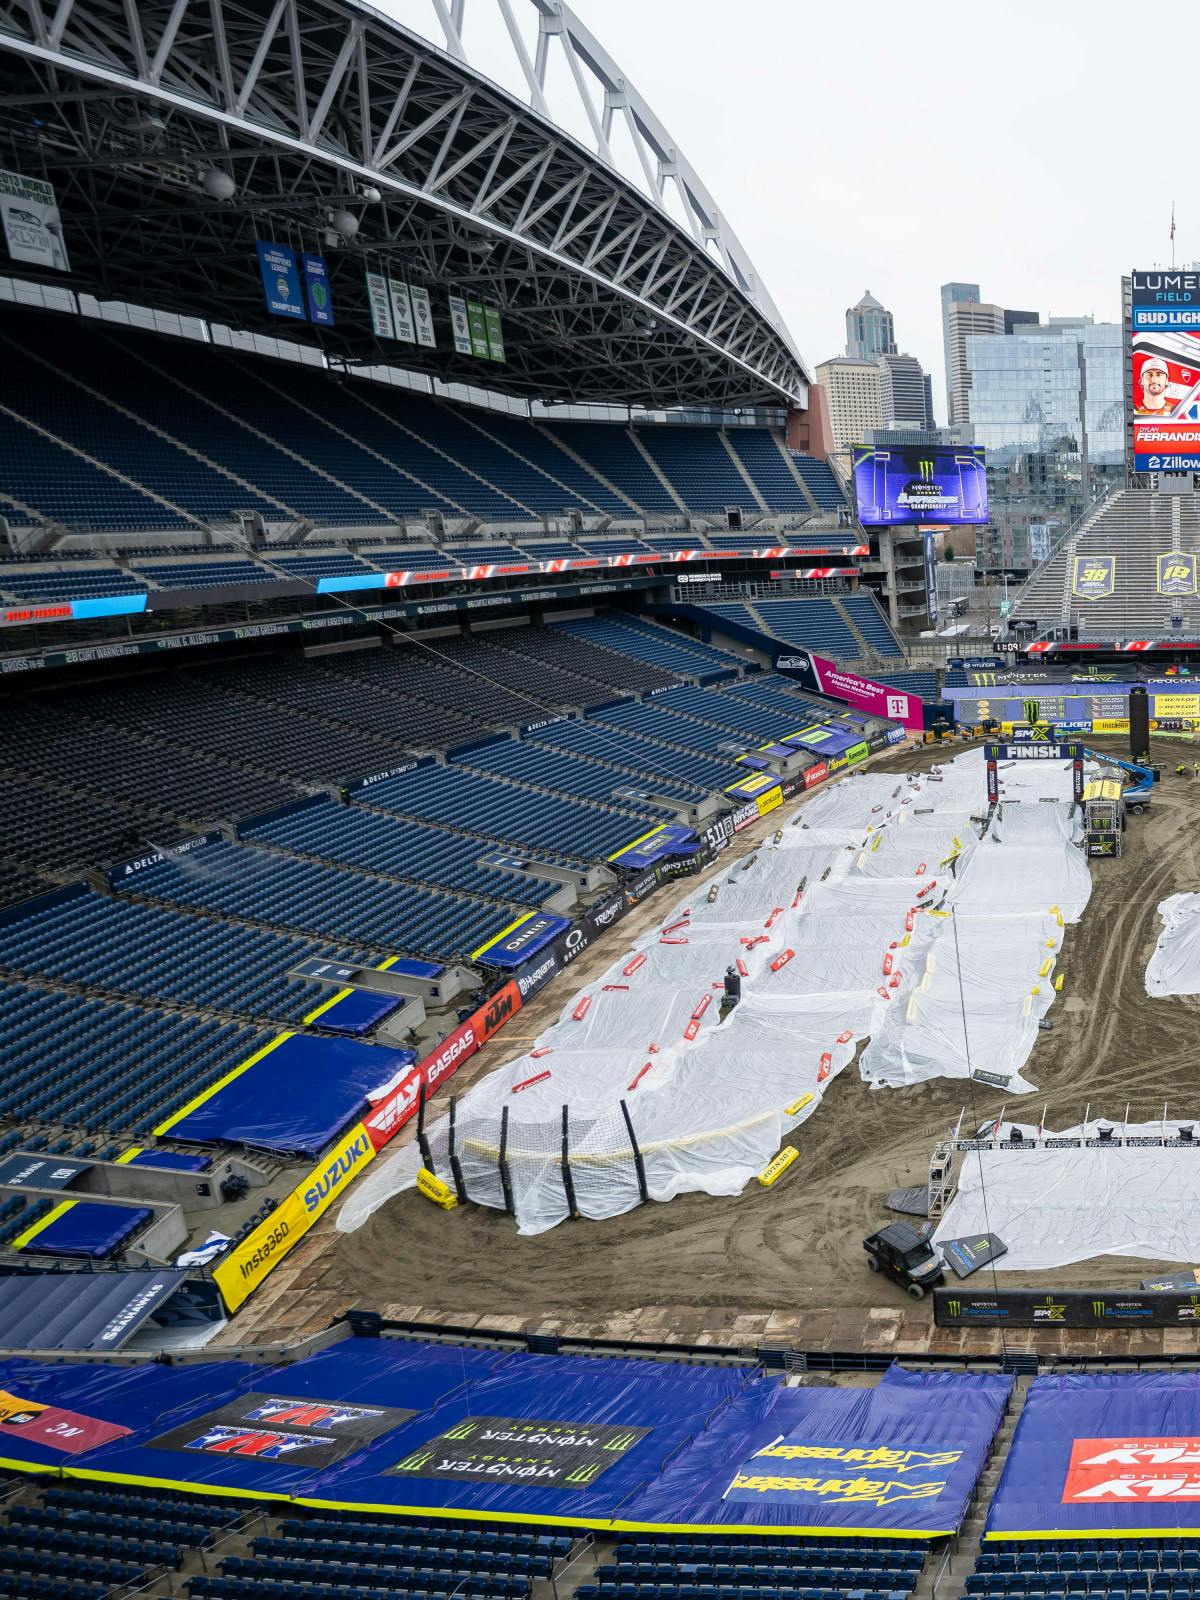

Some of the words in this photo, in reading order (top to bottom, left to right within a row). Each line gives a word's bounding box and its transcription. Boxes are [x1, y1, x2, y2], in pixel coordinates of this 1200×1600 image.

[1156, 292, 1192, 302] FIELD
[1137, 312, 1167, 324] BUD
[1080, 568, 1109, 582] 38
[312, 618, 325, 628] KENNY
[326, 616, 344, 626] EASLEY
[234, 629, 244, 638] 79
[244, 626, 260, 637] JACOB
[261, 625, 277, 635] GREEN
[167, 637, 182, 648] PAUL
[190, 633, 206, 645] ALLEN
[997, 642, 1019, 652] 11:09
[66, 652, 79, 663] 28
[79, 649, 97, 662] CURT
[98, 645, 125, 660] WARNER
[2, 661, 29, 673] GROSS
[824, 670, 865, 689] America's
[865, 683, 885, 695] Best
[997, 672, 1048, 680] MONSTER
[831, 680, 850, 691] Mobile
[850, 686, 876, 698] Network
[892, 700, 904, 714] T
[532, 720, 547, 730] DELTA
[1014, 727, 1050, 741] SMX
[1007, 745, 1061, 759] FINISH
[369, 771, 389, 784] DELTA
[707, 822, 725, 848] 5.11
[1090, 842, 1113, 854] SMX
[133, 853, 165, 871] DELTA
[661, 857, 697, 873] MONSTER
[594, 897, 623, 927] TRIUMPH
[506, 919, 548, 951] OAKLEY
[564, 937, 588, 963] OAKLEY
[775, 953, 790, 967] FLY
[524, 956, 556, 990] Husqvarna
[484, 993, 513, 1032] KTM
[427, 1029, 475, 1081] GASGAS
[369, 1071, 422, 1132] FLY
[304, 1134, 371, 1215] SUZUKI
[419, 1175, 444, 1201] DUNLOP
[240, 1221, 290, 1280] Insta360
[102, 1283, 164, 1341] SEAHAWKS
[1033, 1307, 1066, 1319] SMX
[44, 1424, 86, 1438] NC
[509, 1426, 593, 1435] ENERGY
[479, 1429, 600, 1448] MONSTER
[467, 1454, 553, 1465] ENERGY
[436, 1459, 562, 1478] MONSTER
